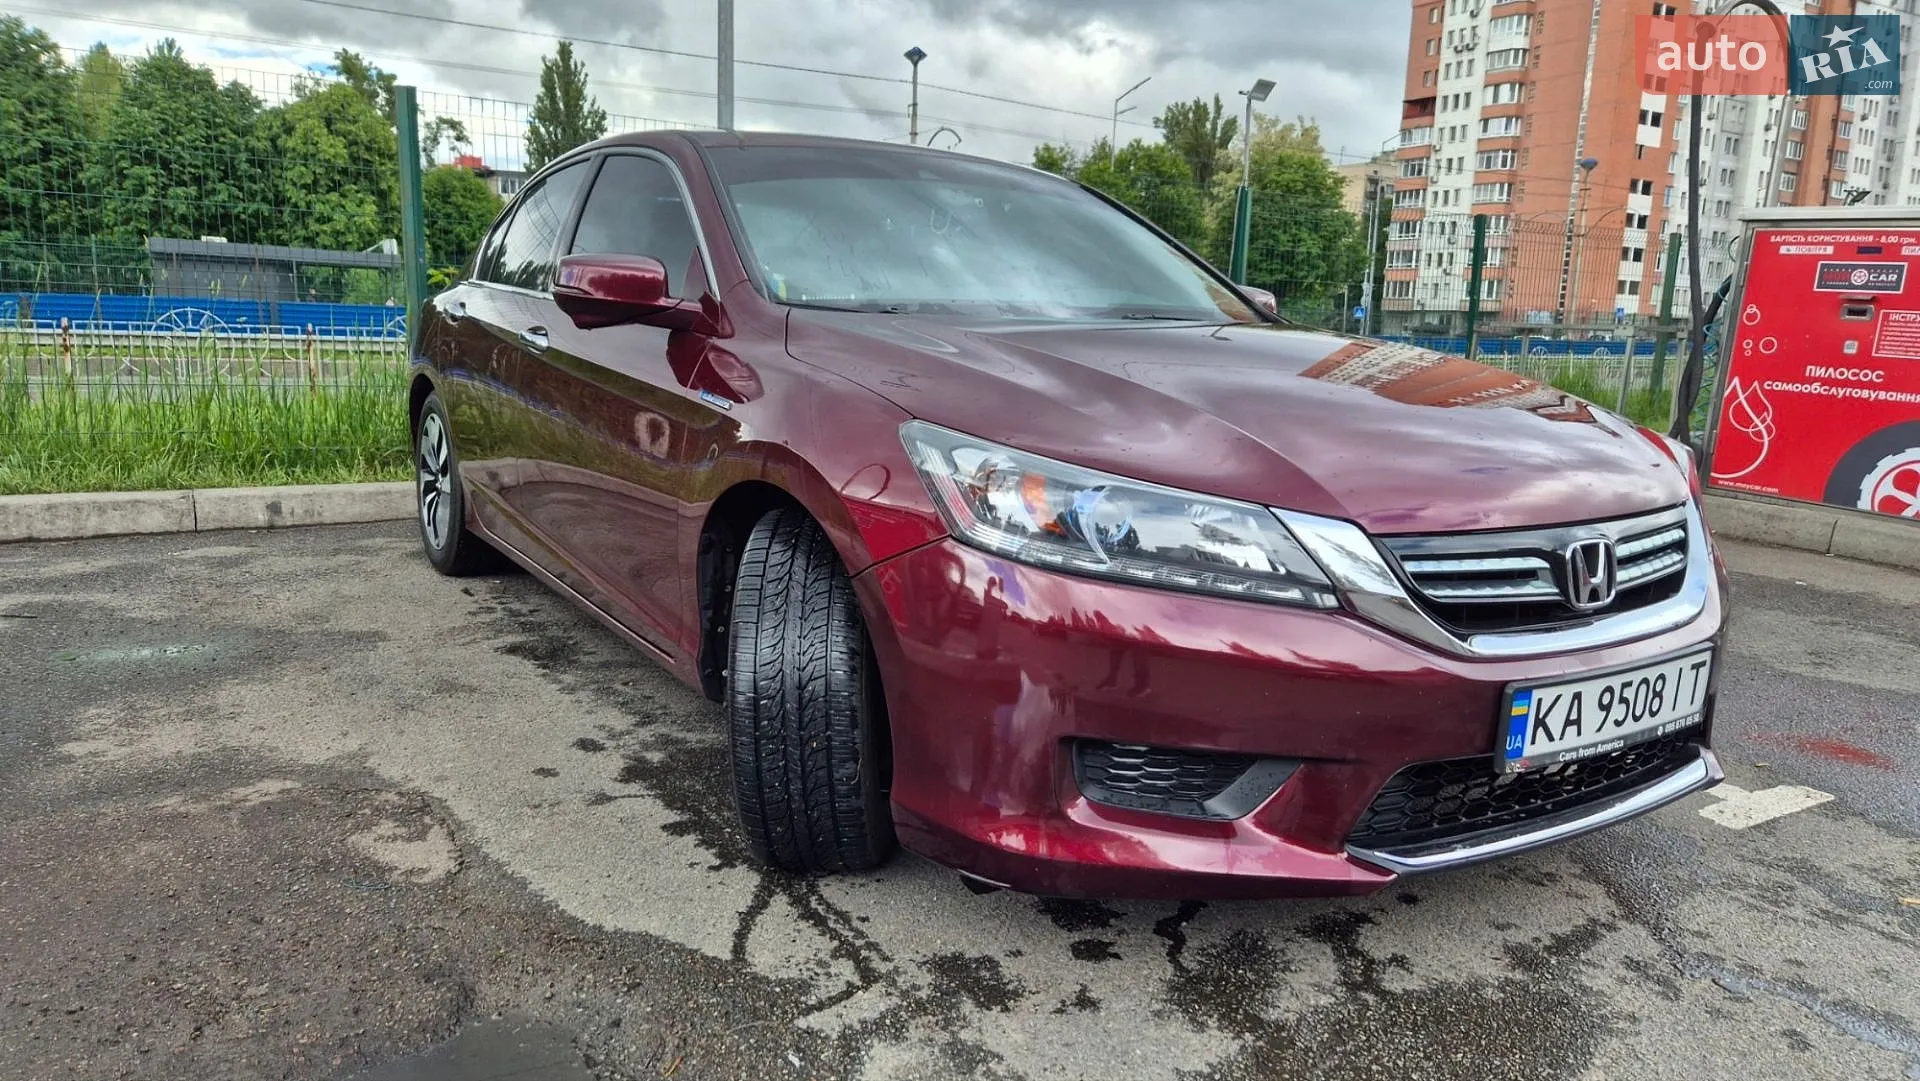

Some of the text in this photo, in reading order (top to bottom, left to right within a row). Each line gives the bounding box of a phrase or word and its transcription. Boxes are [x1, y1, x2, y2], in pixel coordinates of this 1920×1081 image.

[1869, 273, 1898, 281] CAR
[1805, 365, 1885, 382] ПИЛОСОС
[1530, 690, 1583, 745] KA
[1595, 672, 1667, 733] 9508
[1505, 734, 1523, 750] UA
[1559, 739, 1624, 762] Cars from America
